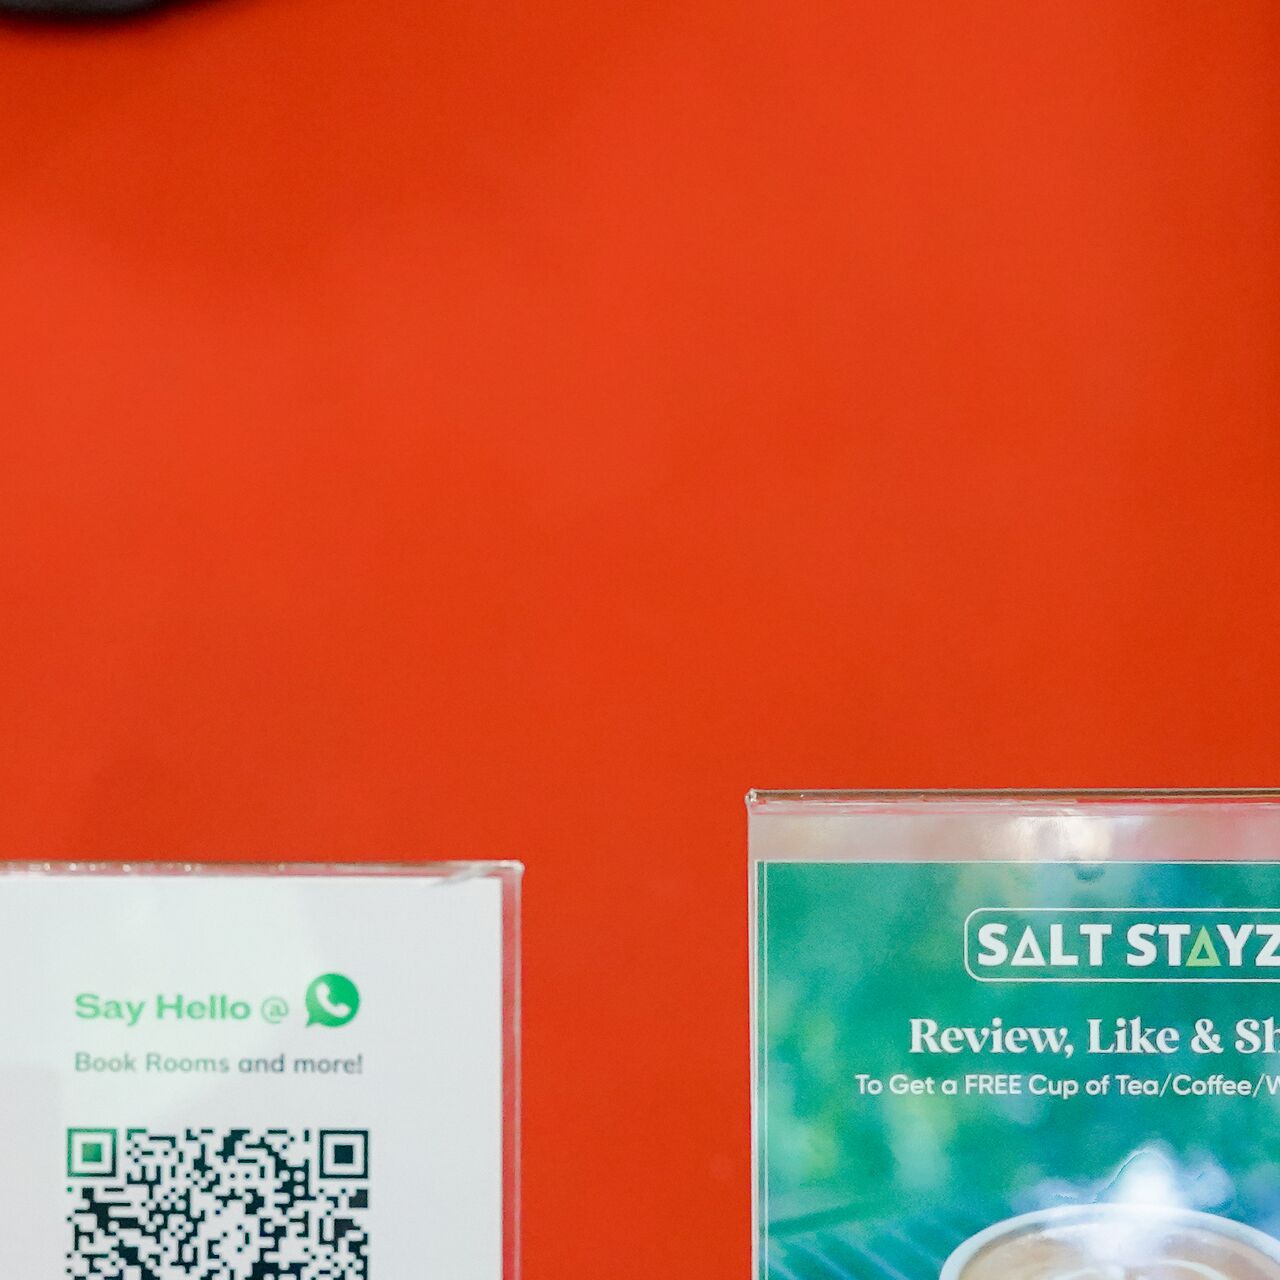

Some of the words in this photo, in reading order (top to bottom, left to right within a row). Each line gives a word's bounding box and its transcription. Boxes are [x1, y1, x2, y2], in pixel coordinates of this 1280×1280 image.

[977, 923, 1112, 967] SALT
[74, 992, 146, 1026] Say
[156, 993, 252, 1020] Hello
[261, 996, 289, 1024] @
[908, 1016, 1073, 1057] Review,
[1086, 1016, 1182, 1054] Like
[1191, 1017, 1225, 1054] &
[74, 1051, 137, 1074] Book
[146, 1052, 230, 1075] Rooms
[238, 1053, 285, 1075] and
[294, 1054, 363, 1075] more!
[855, 1074, 883, 1096] To
[889, 1073, 934, 1096] Get
[941, 1078, 958, 1096] a
[965, 1074, 1022, 1096] FREE
[1028, 1074, 1078, 1100] Cup
[1085, 1073, 1112, 1096] of
